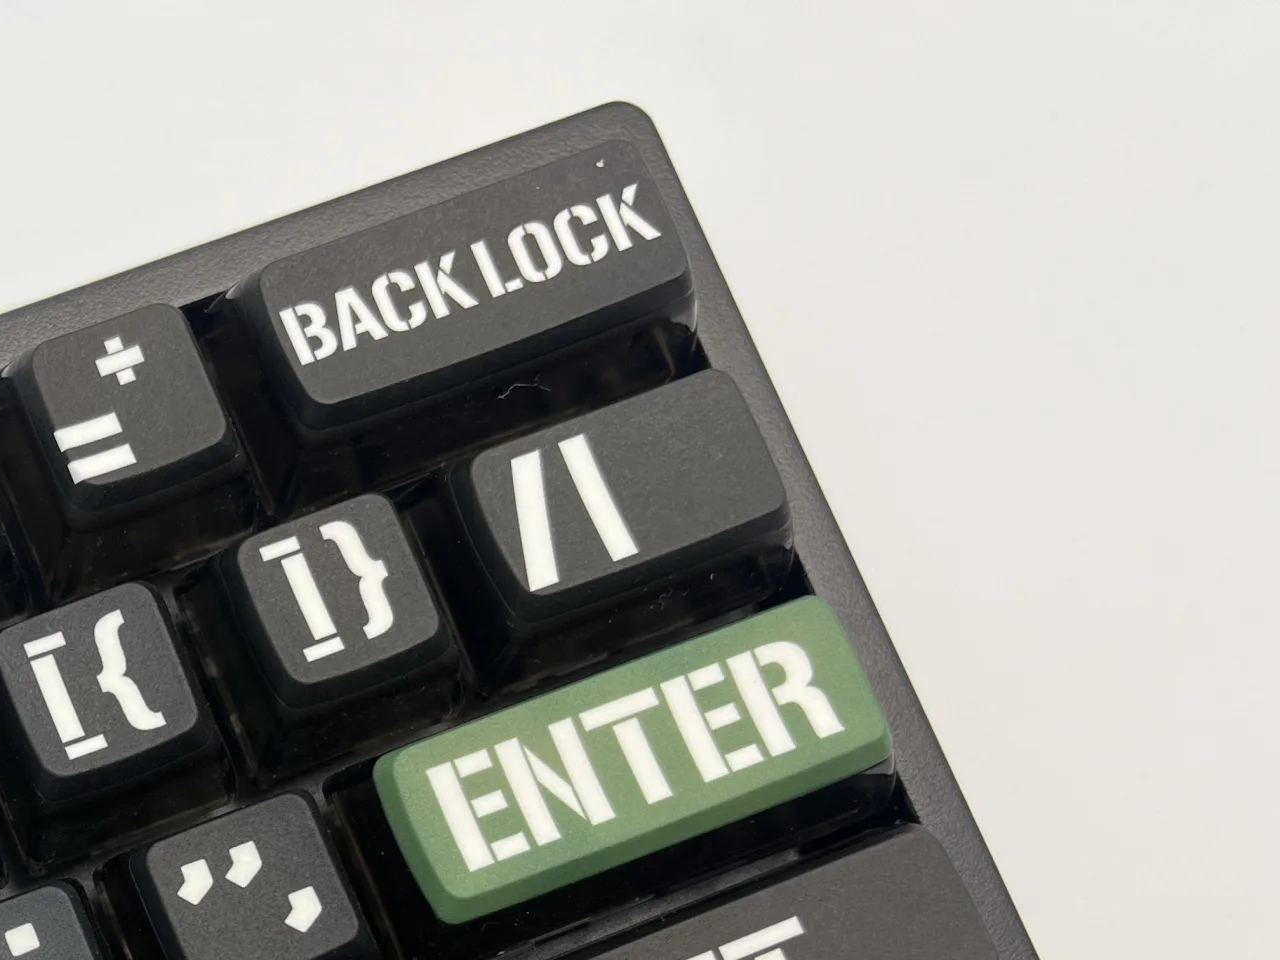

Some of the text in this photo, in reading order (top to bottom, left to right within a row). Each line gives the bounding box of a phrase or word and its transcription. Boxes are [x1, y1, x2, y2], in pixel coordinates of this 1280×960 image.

[279, 184, 661, 366] BACK LOCK
[426, 642, 845, 872] ENTER
